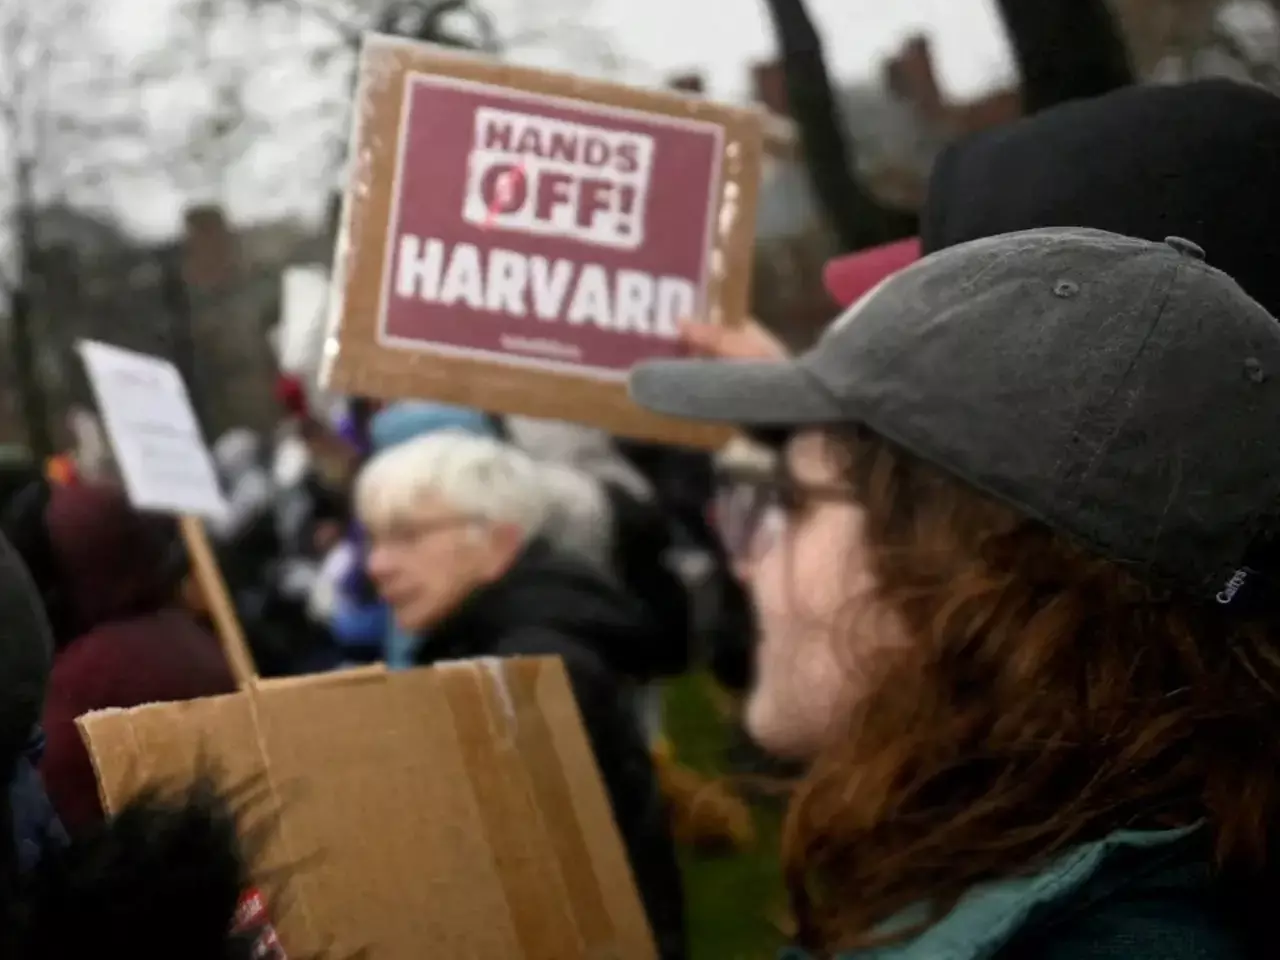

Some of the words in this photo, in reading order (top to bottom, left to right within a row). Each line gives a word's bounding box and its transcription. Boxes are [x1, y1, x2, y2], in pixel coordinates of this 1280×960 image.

[485, 119, 640, 173] HANDS
[481, 161, 637, 236] OFF!
[395, 234, 695, 339] HARVARD
